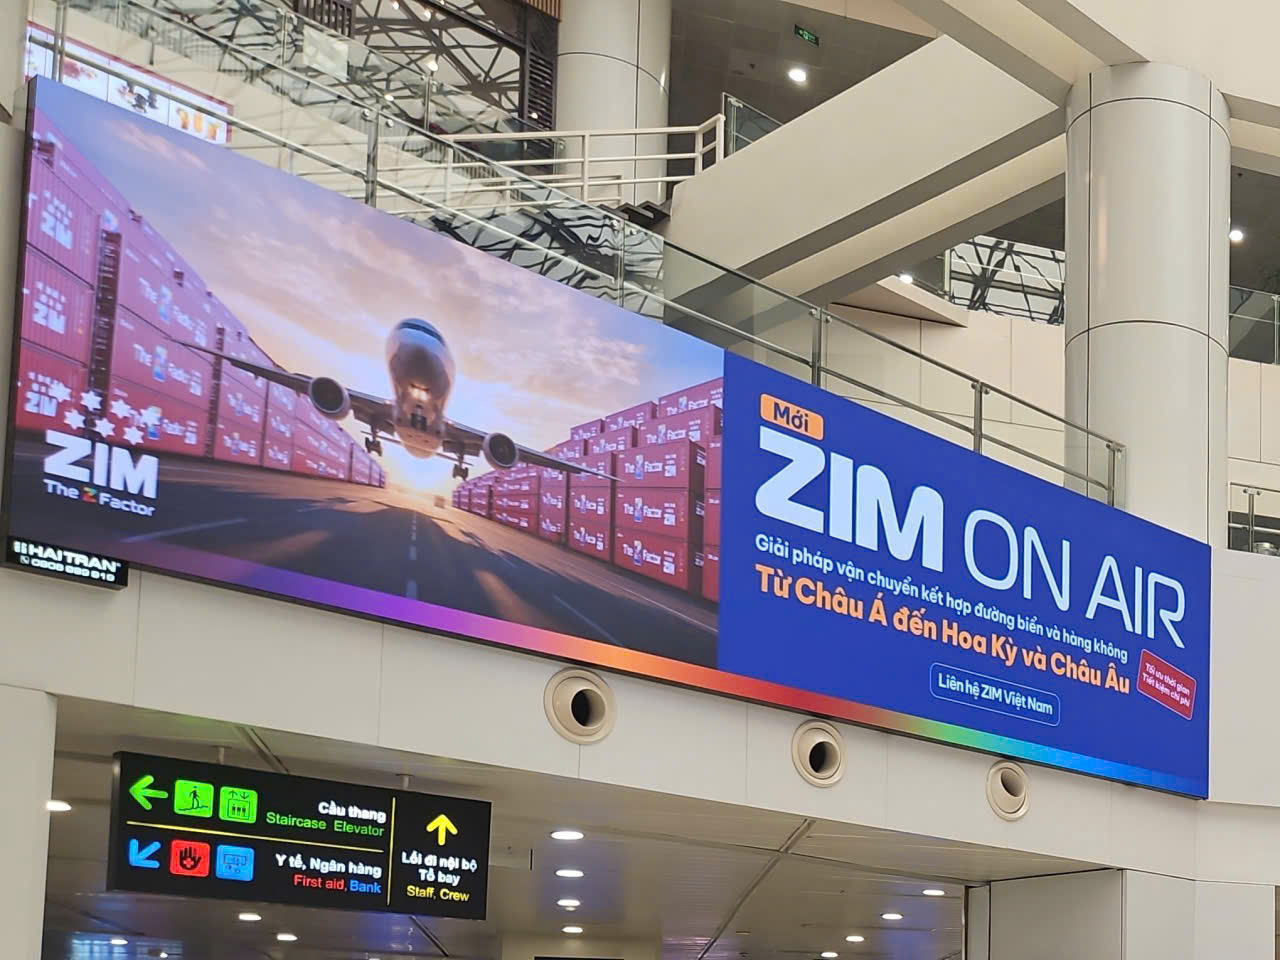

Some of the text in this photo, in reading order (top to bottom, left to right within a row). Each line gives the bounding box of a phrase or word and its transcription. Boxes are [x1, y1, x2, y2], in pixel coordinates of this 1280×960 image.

[773, 400, 809, 433] Mới
[44, 429, 160, 499] ZIM
[43, 478, 155, 516] The Factor
[755, 425, 1185, 648] ZIM ON AIR
[755, 533, 1128, 664] Giải pháp vận chuyển kết hợp đường biển và hàng không
[755, 563, 1130, 695] Từ Châu Á đến Hoa Kỳ và Châu Âu
[938, 672, 1053, 715] Liên hệ ZIM Việt Nam
[266, 812, 384, 837] Staircase Elevator
[318, 800, 386, 824] Cầu thang
[275, 854, 287, 867] Y
[310, 857, 346, 874] Ngân
[348, 861, 383, 879] hàng
[424, 853, 438, 867] đi
[461, 856, 478, 873] bộ
[293, 874, 382, 894] First aid, Bank
[406, 885, 470, 902] Staff, Crew
[437, 871, 461, 887] bay
